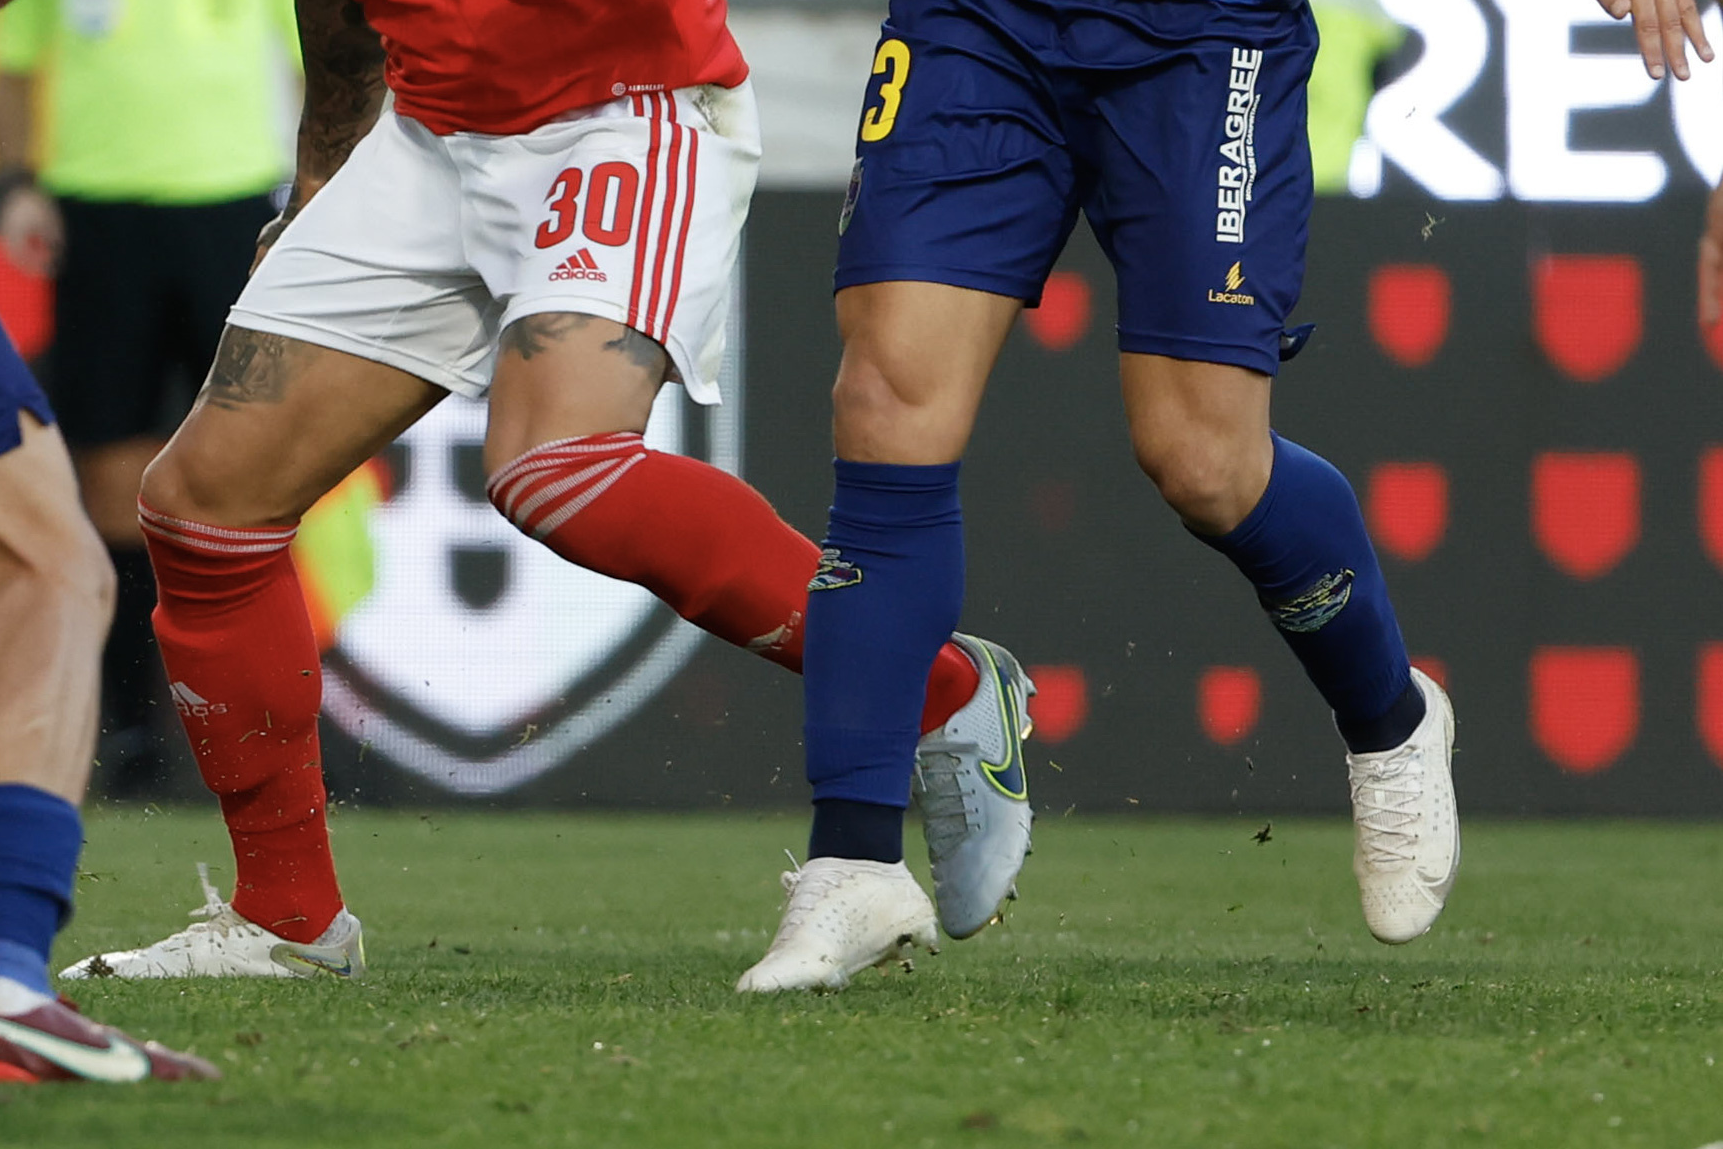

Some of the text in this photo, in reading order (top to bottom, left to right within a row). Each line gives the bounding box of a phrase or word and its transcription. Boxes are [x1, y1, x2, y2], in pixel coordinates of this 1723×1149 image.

[1216, 47, 1258, 244] IBERAGREE
[534, 161, 639, 249] 30
[548, 269, 608, 283] adidas
